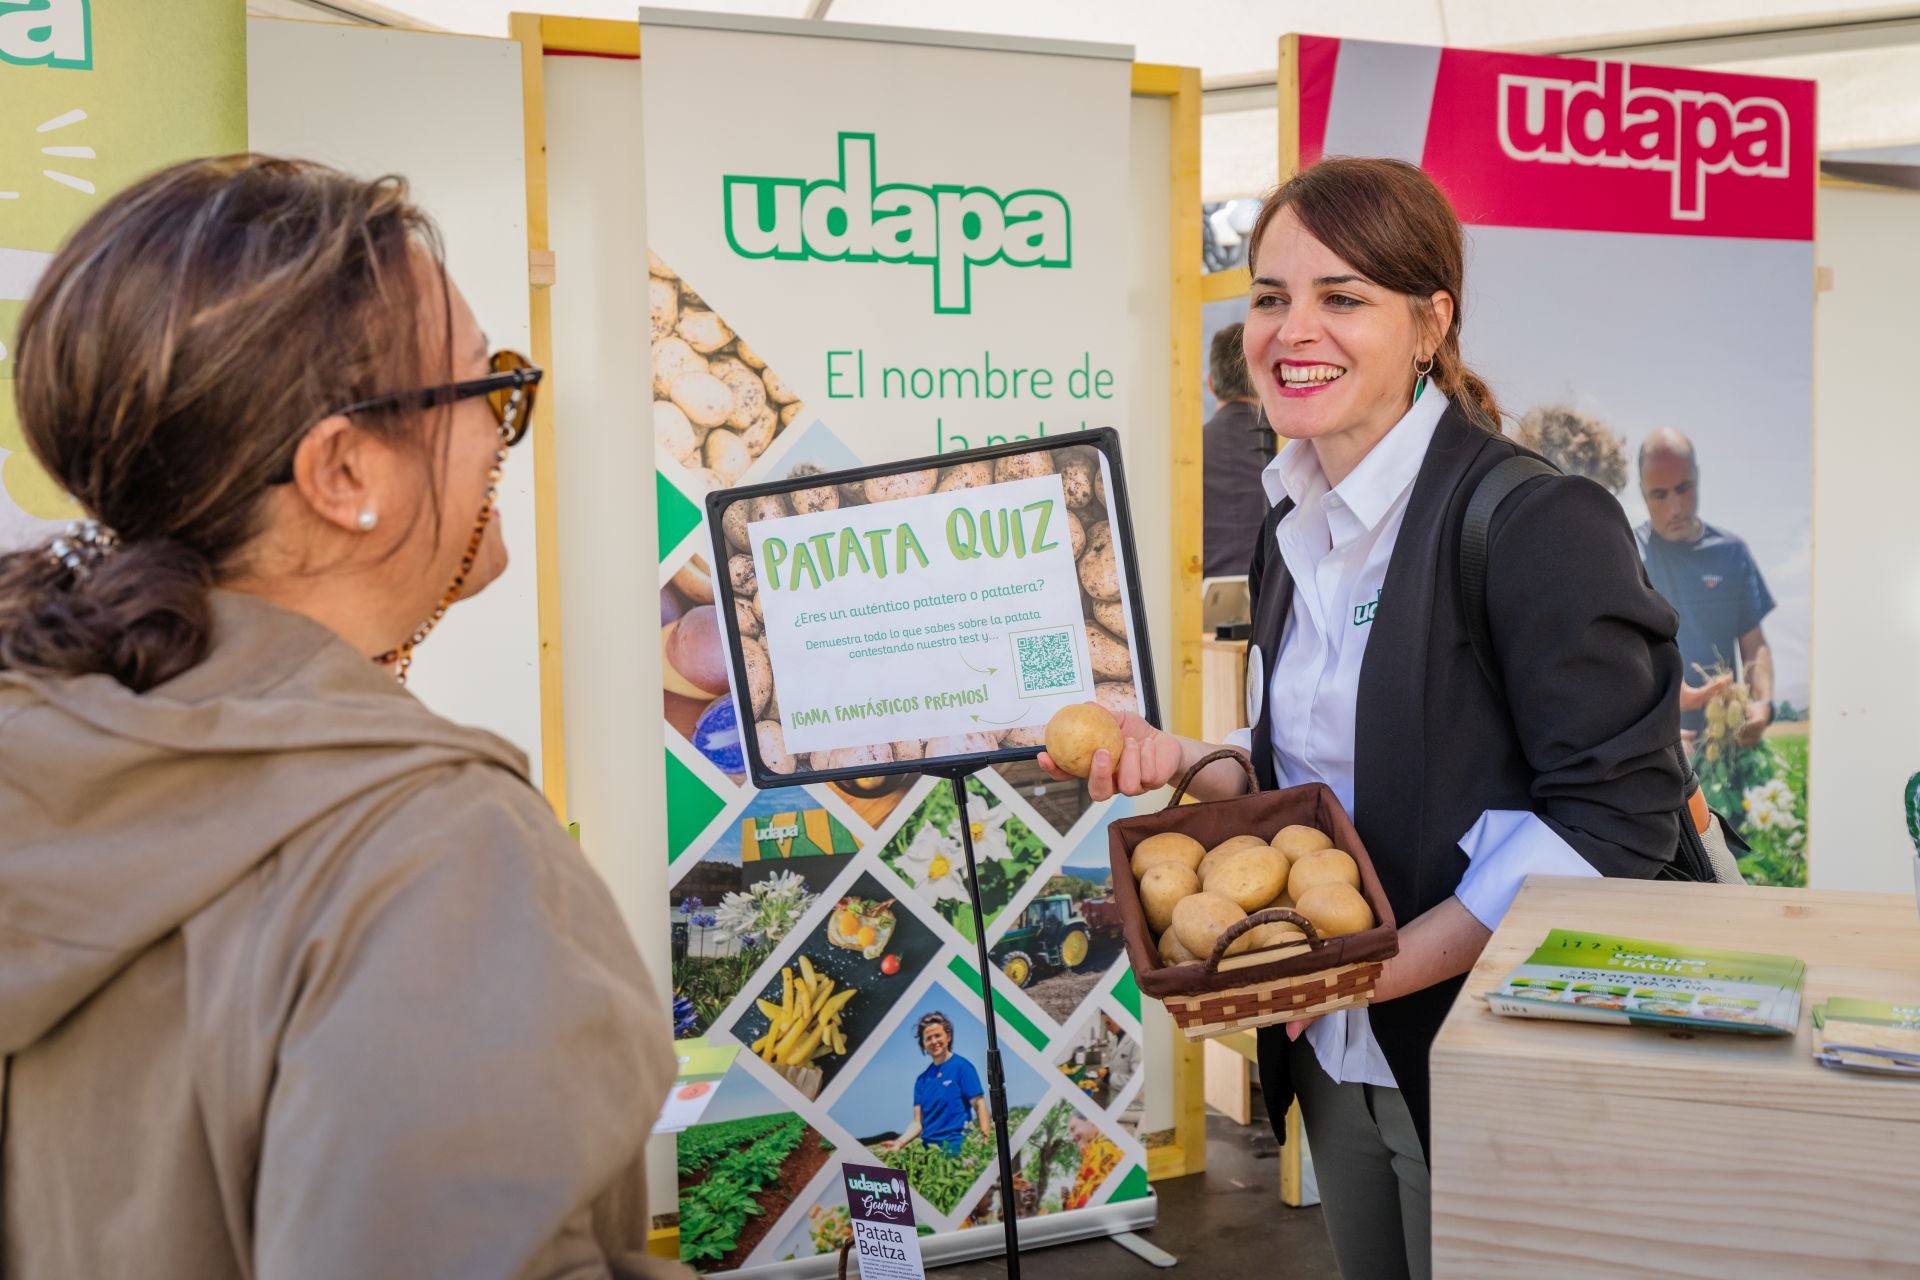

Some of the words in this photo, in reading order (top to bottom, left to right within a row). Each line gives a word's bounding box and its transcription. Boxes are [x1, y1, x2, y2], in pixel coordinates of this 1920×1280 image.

[1498, 60, 1791, 221] udapa
[723, 131, 1072, 314] udapa
[827, 349, 865, 400] El
[882, 350, 1054, 400] nombre
[1068, 351, 1114, 400] de
[762, 522, 930, 591] PATATA
[945, 499, 1059, 561] QUIZ
[794, 611, 827, 628] ¿Eres
[830, 609, 848, 621] un
[850, 600, 911, 618] auténtico
[913, 590, 967, 611] patatero
[970, 590, 978, 601] o
[981, 578, 1045, 602] patatera?
[805, 633, 862, 650] Demuestra
[864, 629, 888, 643] todo
[890, 628, 900, 639] lo
[902, 626, 923, 640] que
[924, 620, 955, 635] sabes
[958, 615, 988, 631] sobre
[990, 614, 1003, 625] la
[1005, 609, 1042, 626] patata
[849, 640, 914, 659] contestando
[916, 636, 957, 651] nuestro
[959, 631, 979, 645] test
[981, 632, 999, 646] y...
[791, 708, 831, 729] ¡GANA
[835, 696, 920, 722] FANTÁSTICOS
[924, 684, 989, 711] PREMIOS!
[754, 821, 799, 845] udapa
[848, 1173, 892, 1199] udapa
[861, 1194, 910, 1217] Gourmet
[855, 1221, 904, 1244] Patata
[859, 1239, 907, 1262] Beltza
